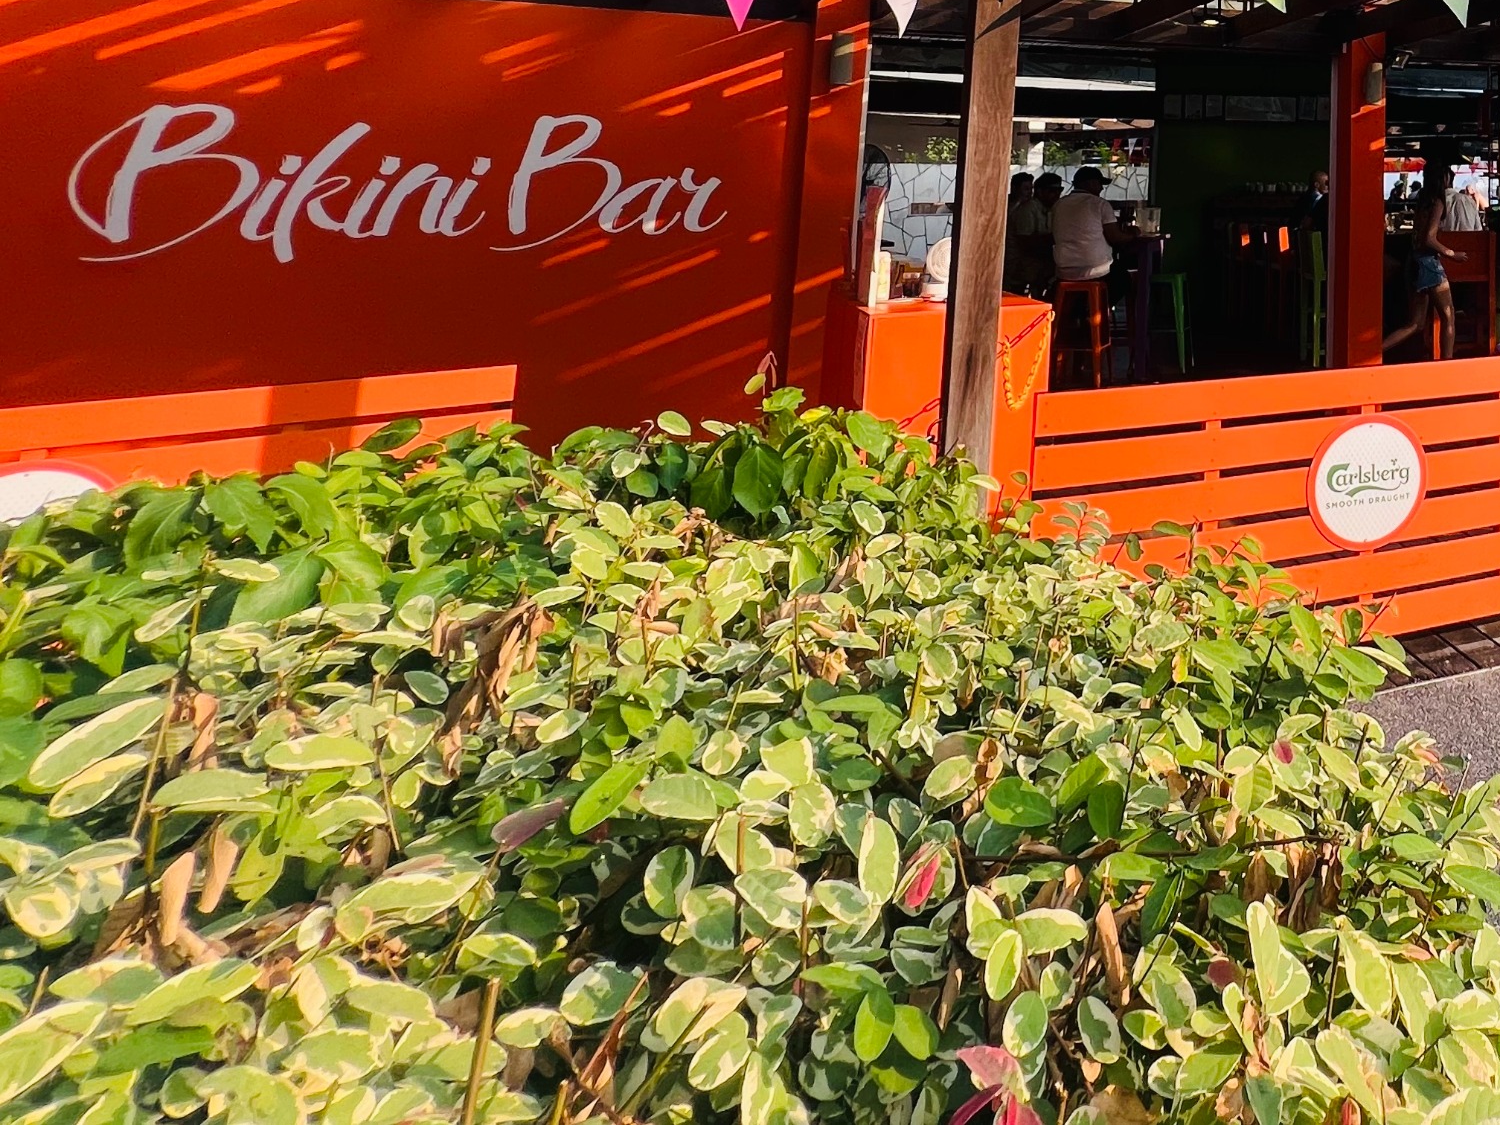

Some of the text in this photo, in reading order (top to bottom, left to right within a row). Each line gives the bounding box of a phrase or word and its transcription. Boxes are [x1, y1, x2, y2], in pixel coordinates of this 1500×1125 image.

[67, 104, 729, 263] Bikini Bar
[1326, 462, 1410, 493] Carlsberg
[1325, 492, 1410, 510] SMOOTH DRAUGHT
